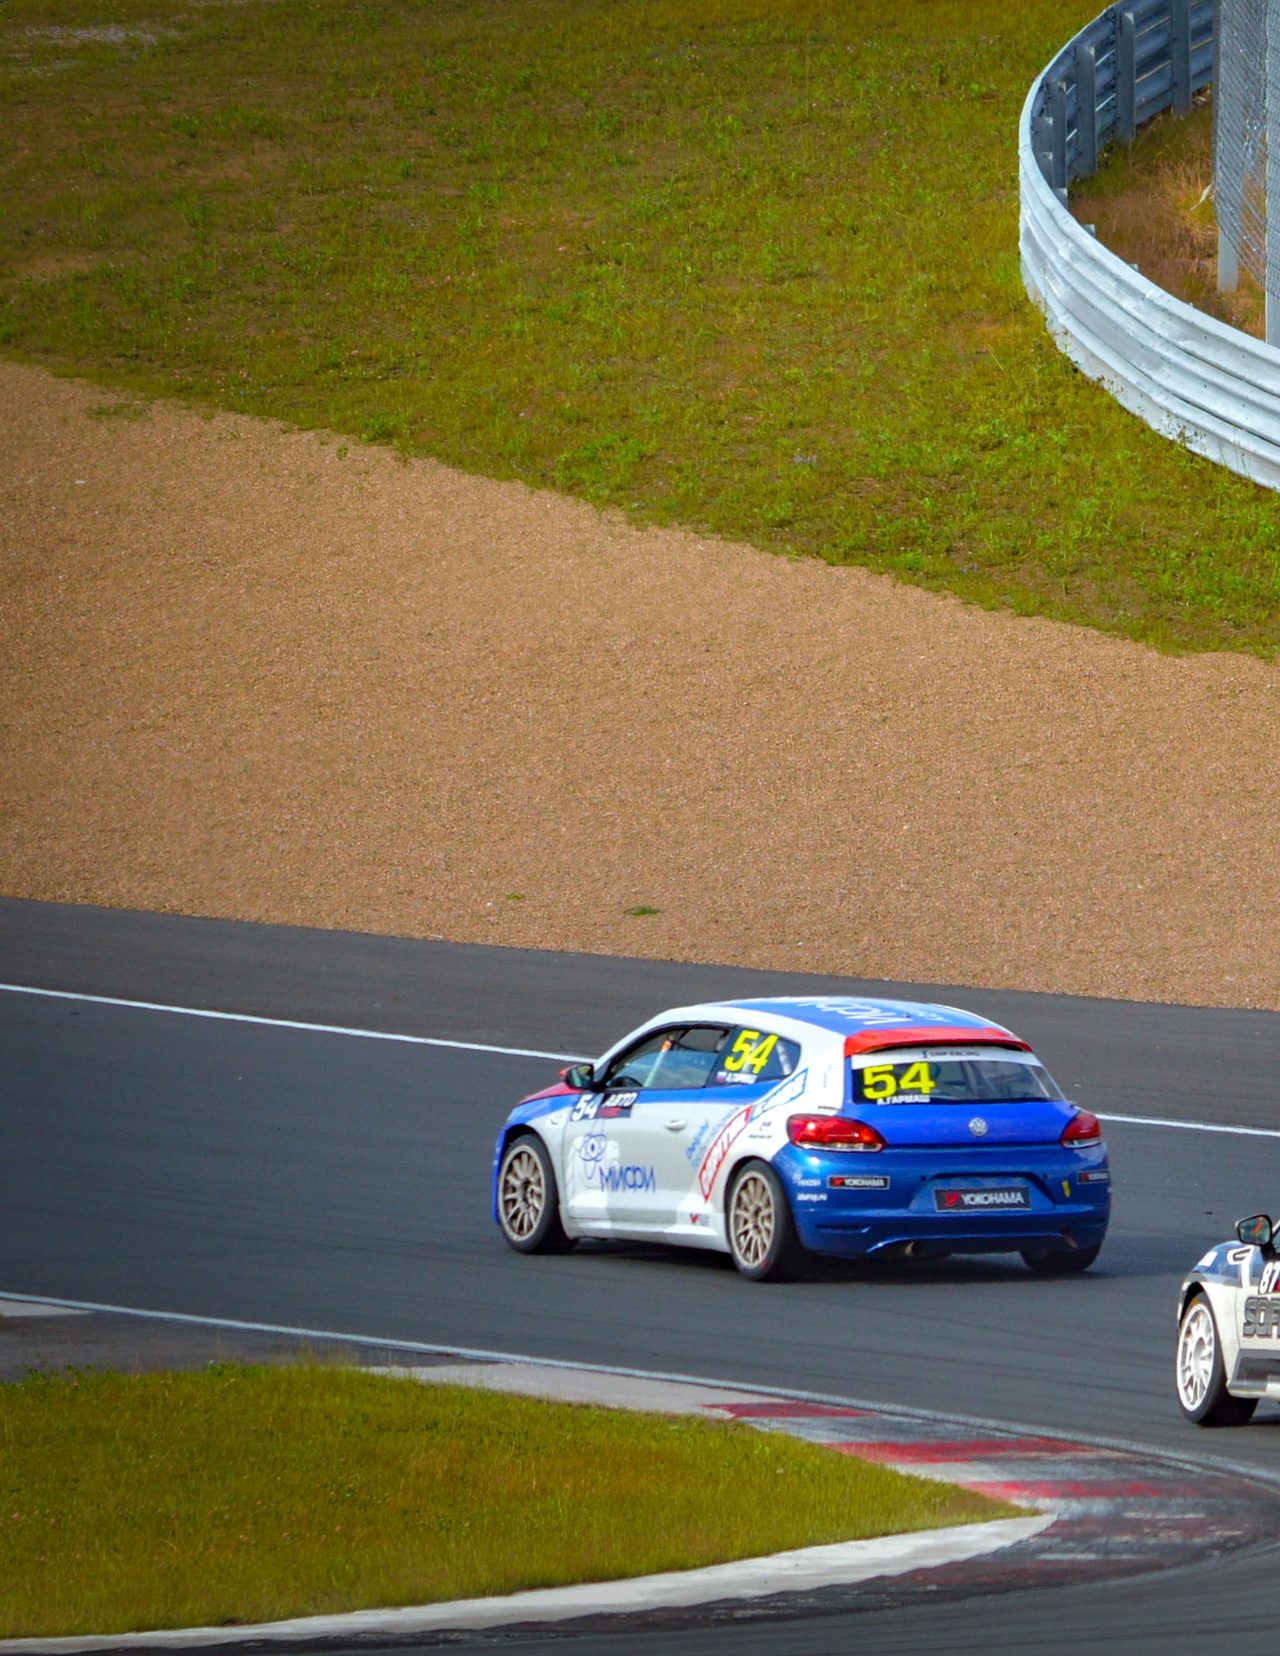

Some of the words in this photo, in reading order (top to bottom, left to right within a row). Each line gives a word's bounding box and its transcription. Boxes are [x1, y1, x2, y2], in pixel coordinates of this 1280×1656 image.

[724, 1029, 779, 1075] 54
[863, 1061, 936, 1099] 54
[571, 1093, 605, 1121] 54
[844, 1178, 885, 1187] YOKOHAMA
[961, 1192, 1025, 1206] YOKOHAMA
